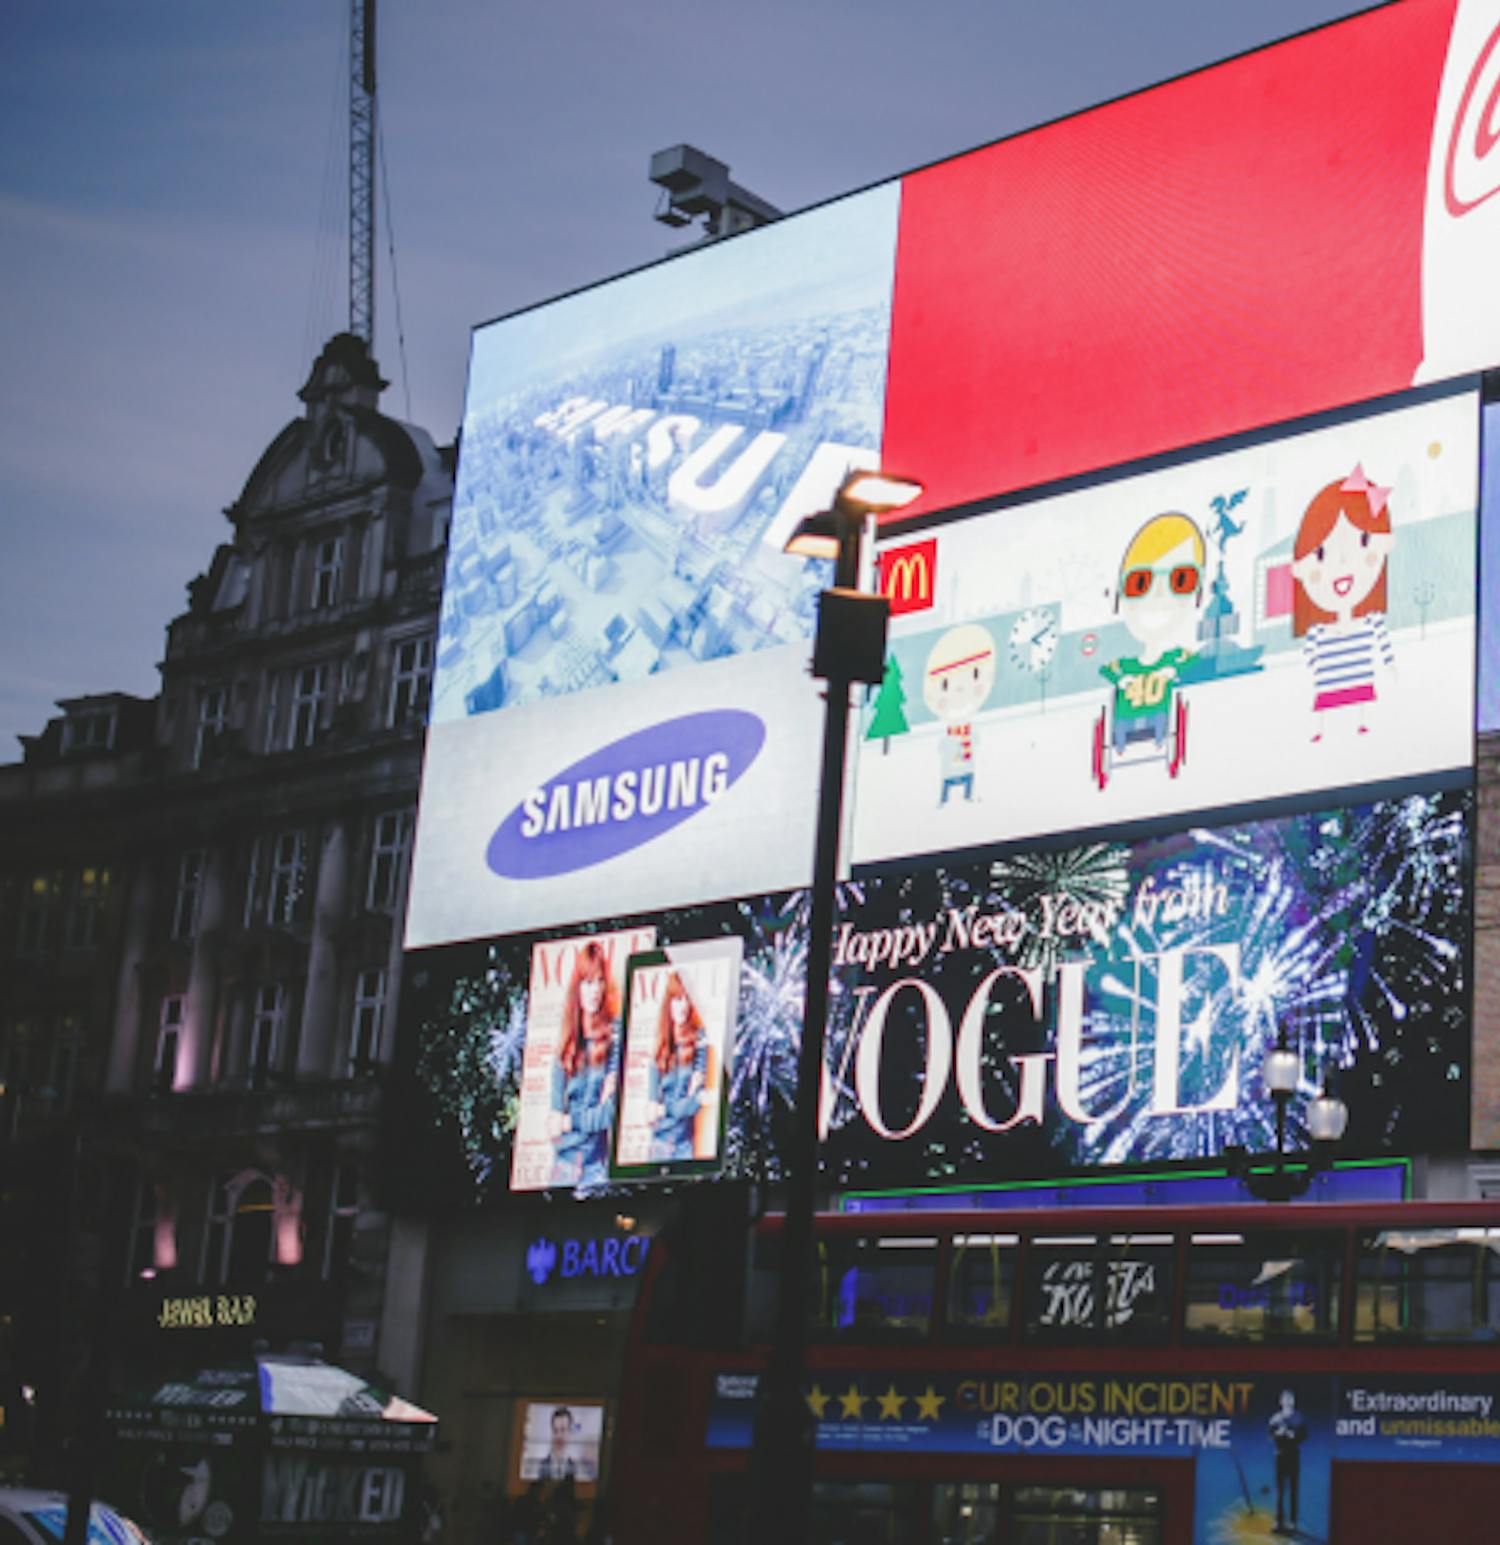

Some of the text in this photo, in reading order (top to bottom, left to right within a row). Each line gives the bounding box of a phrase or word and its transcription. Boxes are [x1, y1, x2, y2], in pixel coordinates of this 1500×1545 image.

[520, 753, 730, 839] SAMSUNG
[940, 906, 1027, 954] New
[1039, 892, 1124, 939] Year
[956, 1380, 1254, 1414] CURIOUS INCIDENT
[991, 1414, 1067, 1447] DOG
[1082, 1416, 1232, 1448] NIGHT-TIME
[1336, 1416, 1375, 1437] and
